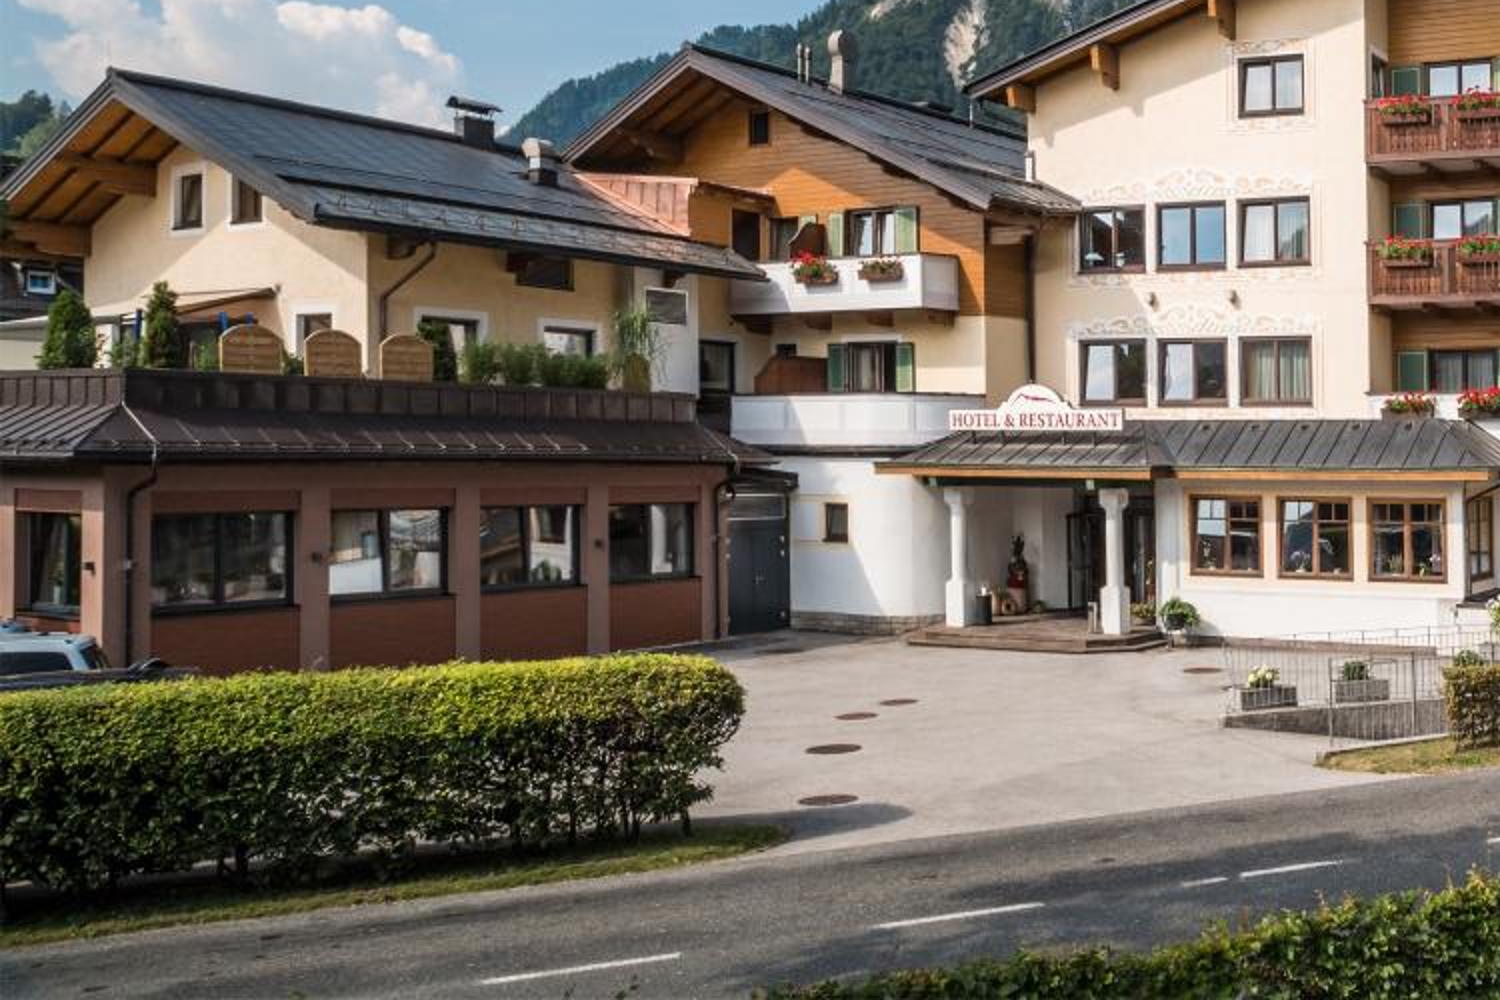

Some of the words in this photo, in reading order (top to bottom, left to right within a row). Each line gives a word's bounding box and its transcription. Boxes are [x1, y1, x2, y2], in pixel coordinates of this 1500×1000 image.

[952, 412, 1000, 428] HOTEL
[1004, 413, 1015, 427] &
[1019, 412, 1121, 428] RESTAURANT
